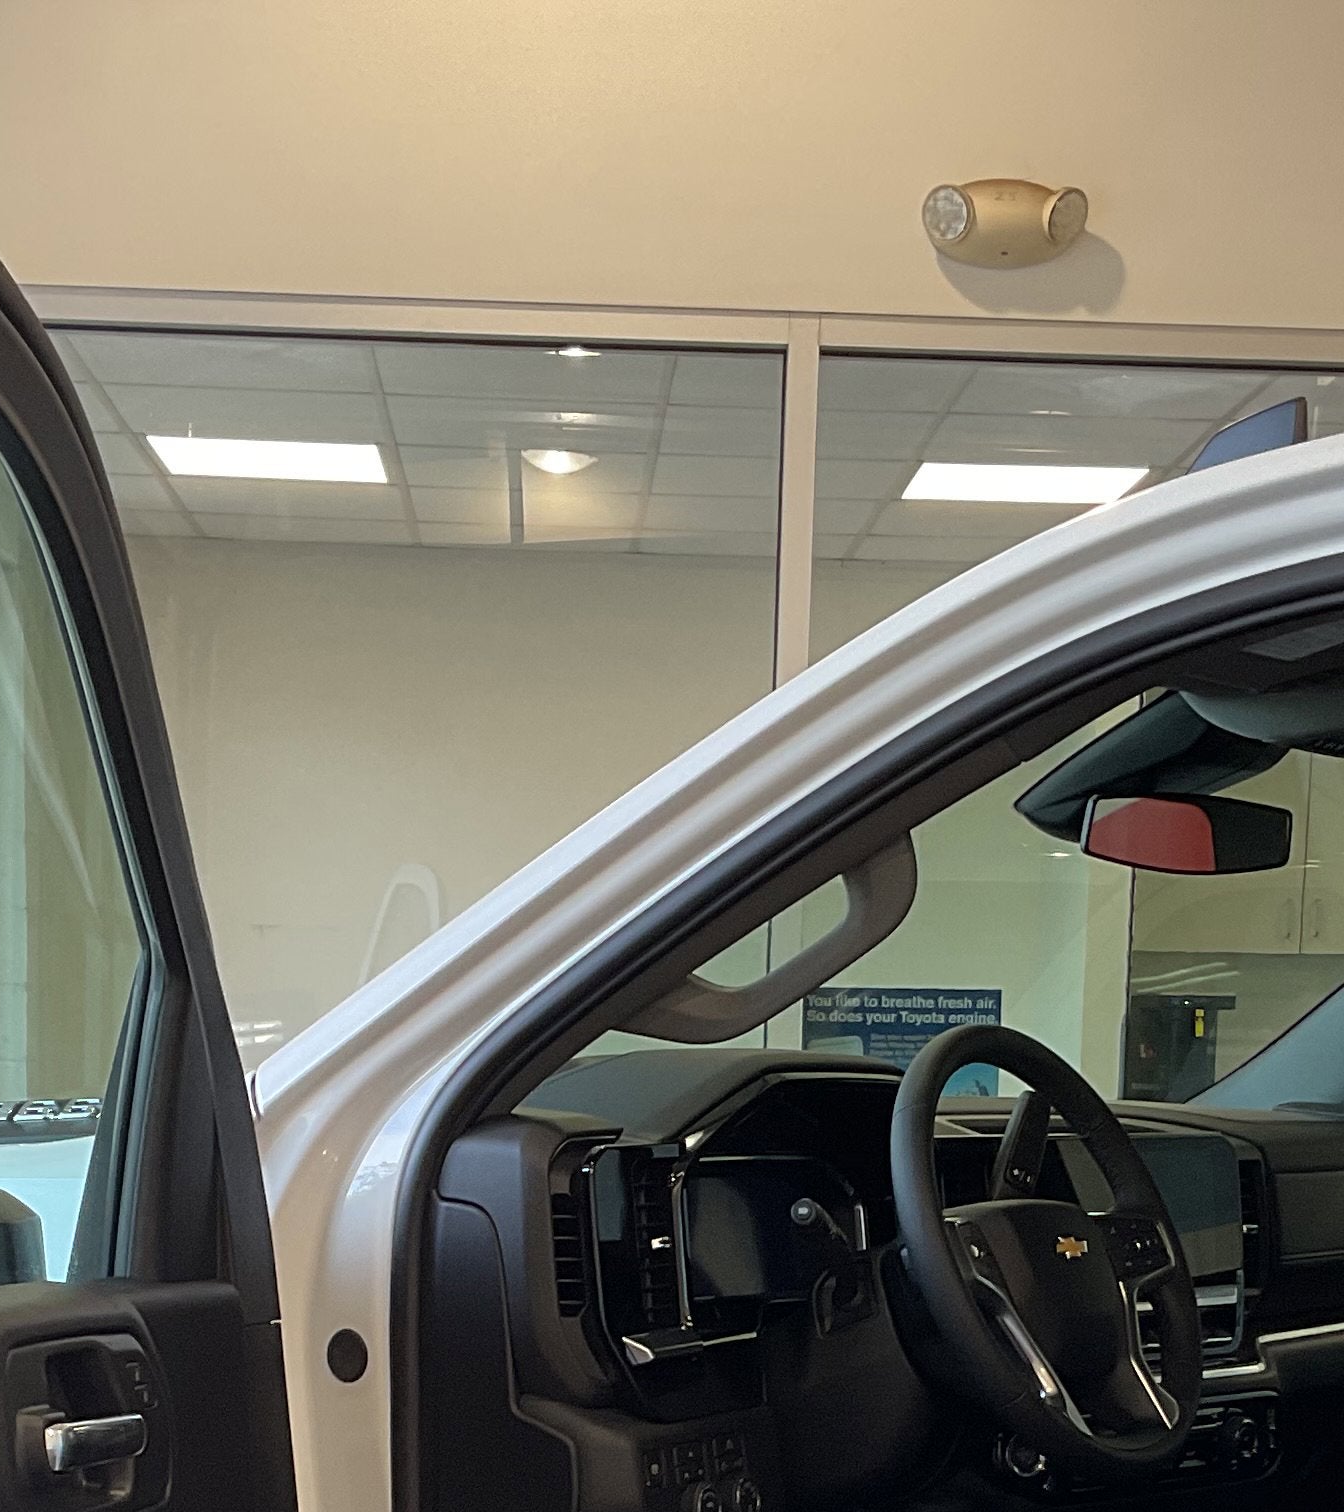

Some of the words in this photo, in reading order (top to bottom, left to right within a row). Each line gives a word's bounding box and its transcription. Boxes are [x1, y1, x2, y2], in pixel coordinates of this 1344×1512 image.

[807, 995, 832, 1007] You
[836, 995, 861, 1008] like
[864, 996, 878, 1008] to
[881, 995, 935, 1009] breathe
[938, 996, 973, 1009] fresh
[976, 997, 996, 1009] air.
[807, 1010, 826, 1022] So
[829, 1010, 864, 1023] does
[866, 1012, 897, 1026] your
[900, 1011, 945, 1026] Toyota
[948, 1012, 999, 1026] engine.
